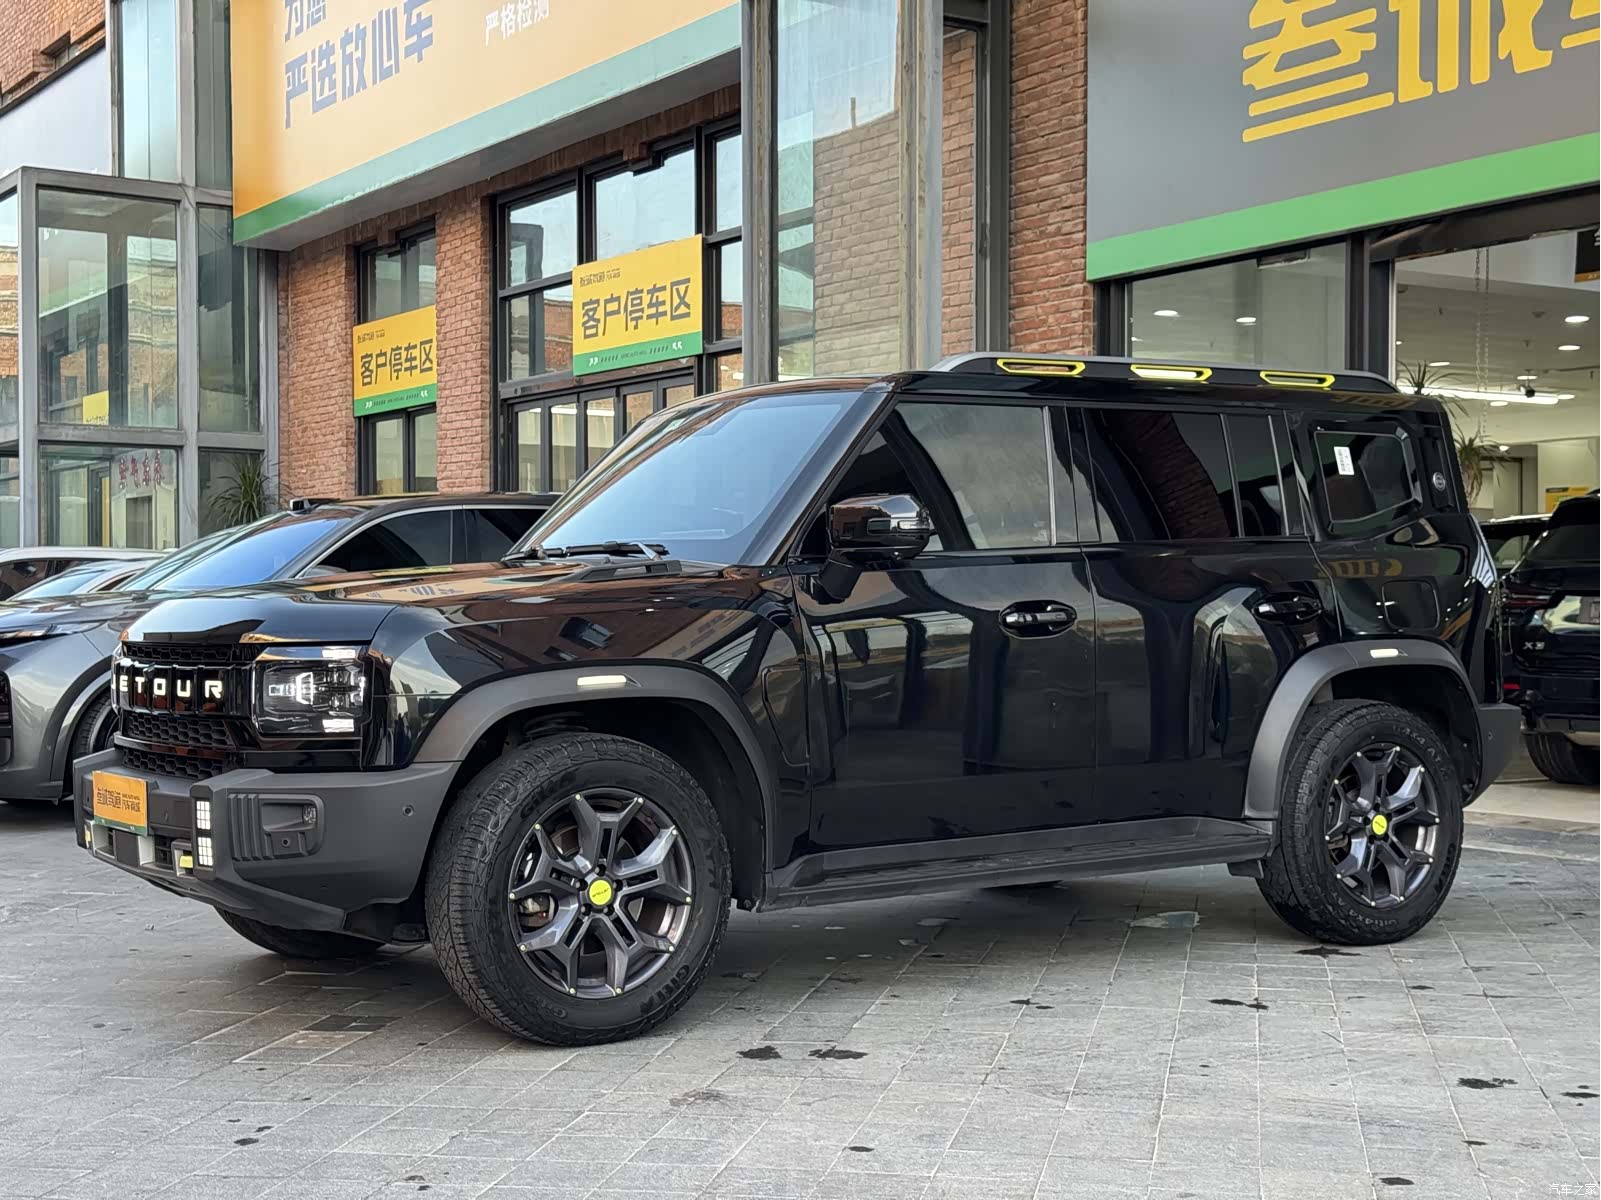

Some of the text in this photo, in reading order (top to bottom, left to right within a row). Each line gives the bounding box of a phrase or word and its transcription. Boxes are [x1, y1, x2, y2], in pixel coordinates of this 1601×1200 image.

[284, 0, 434, 130] 严选放心车
[580, 276, 692, 341] 客户停车区
[360, 338, 434, 387] 客户停车区
